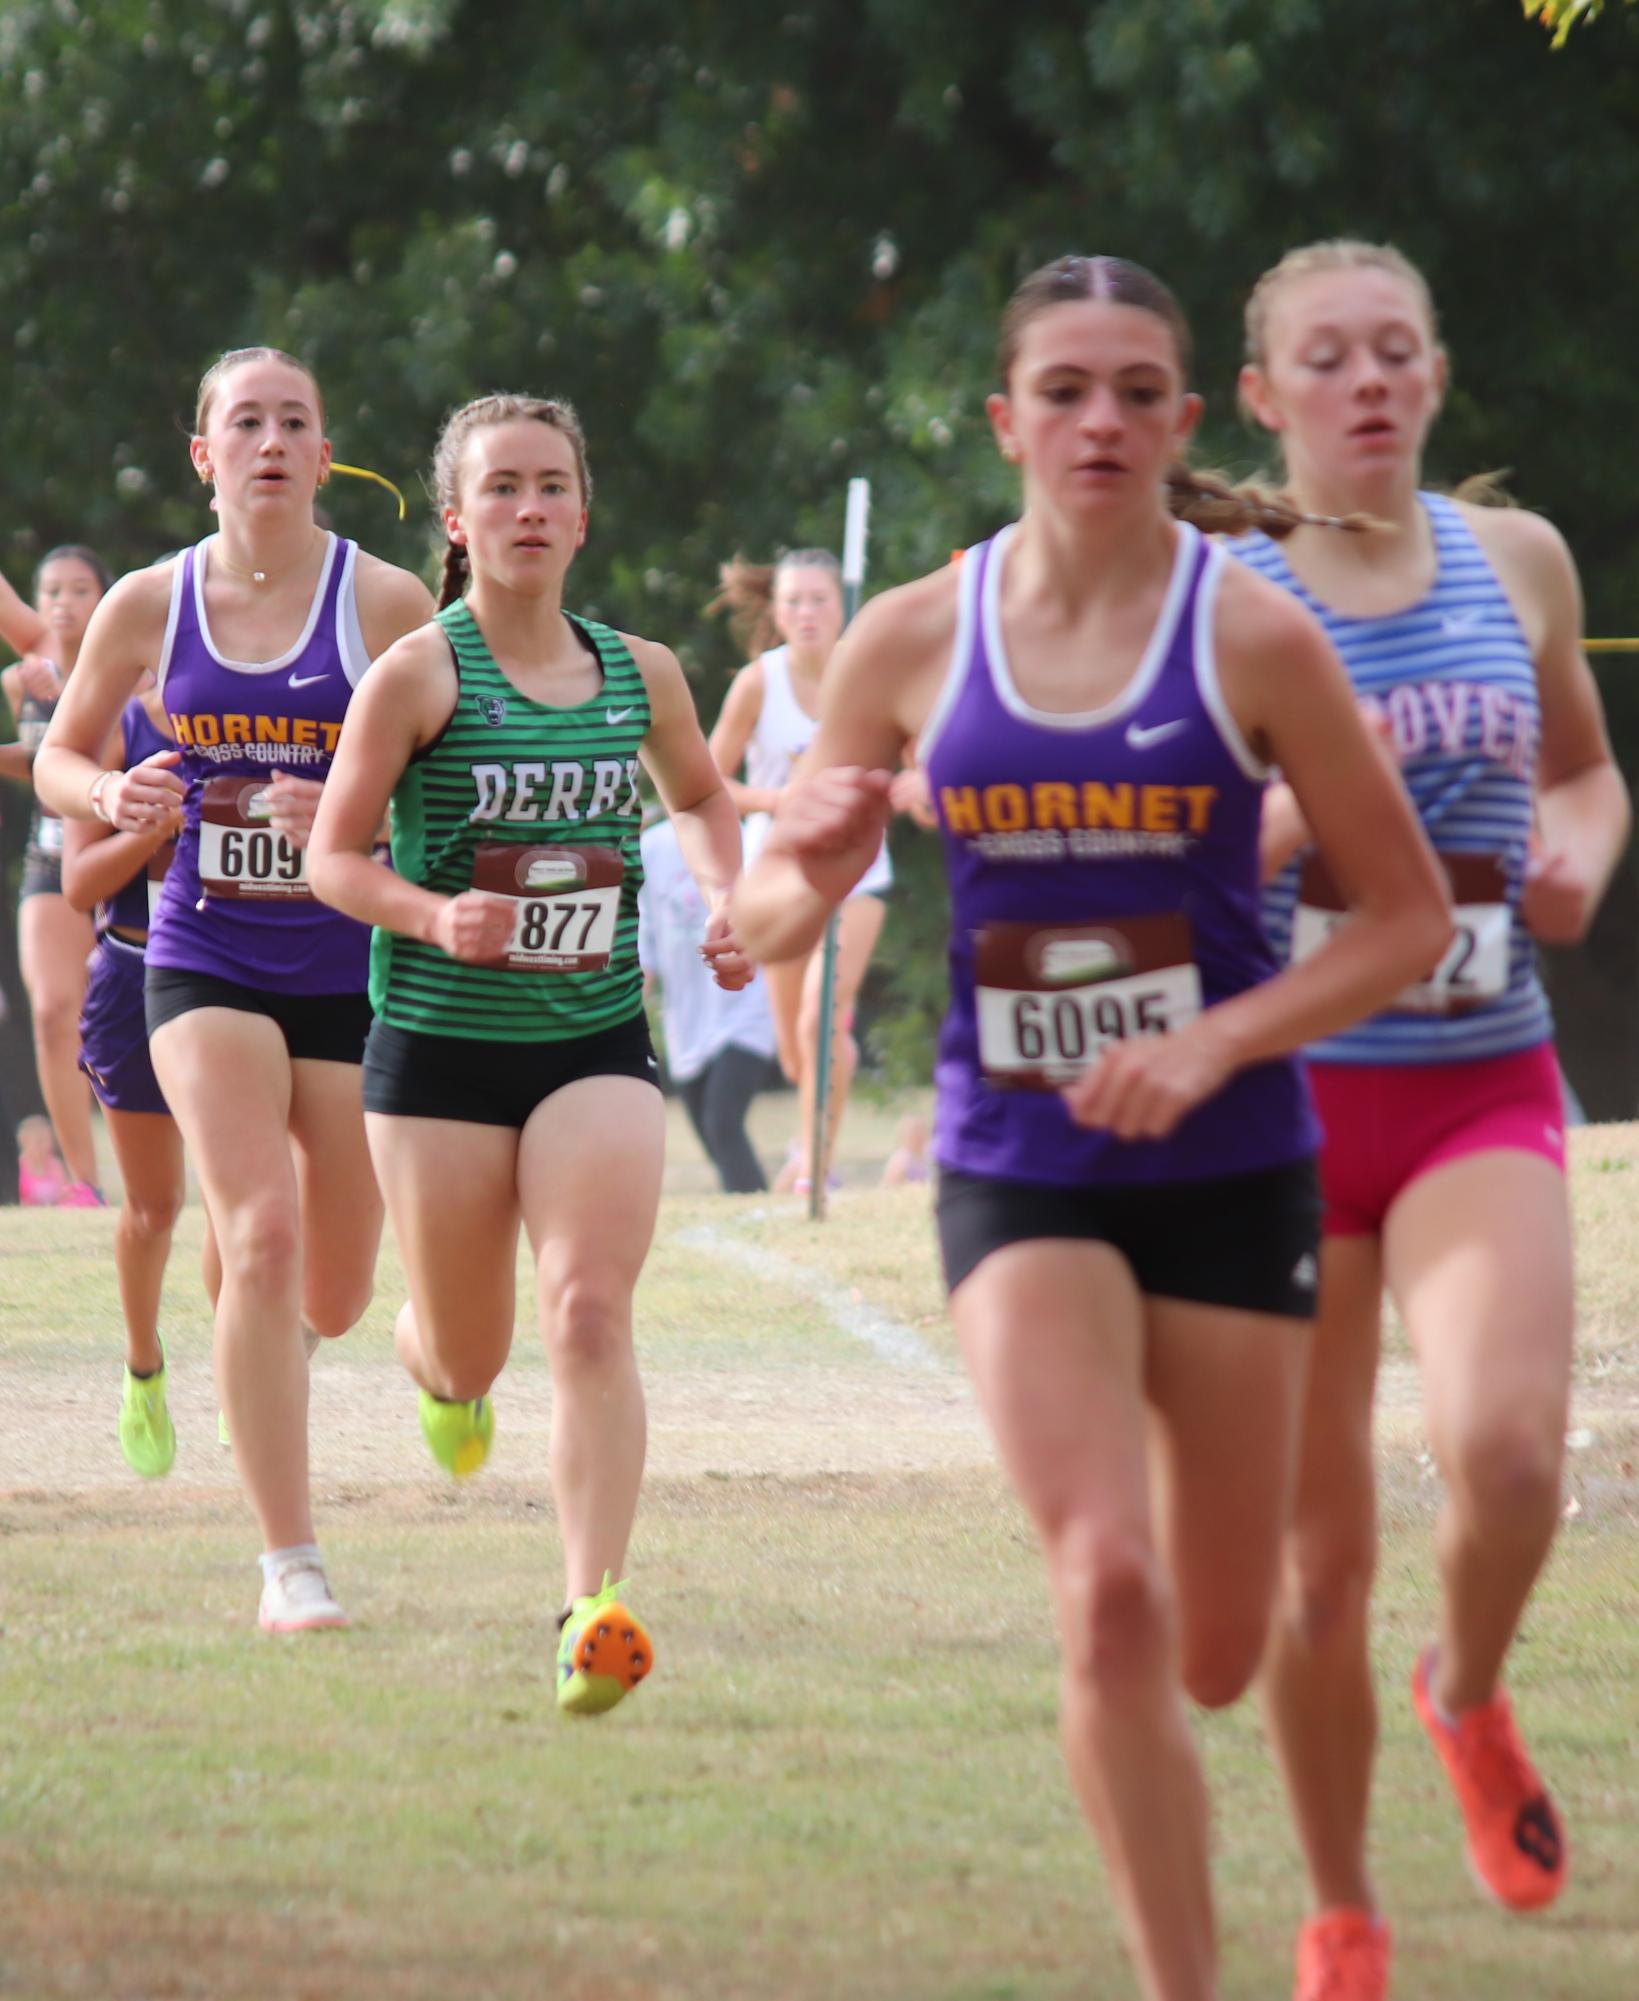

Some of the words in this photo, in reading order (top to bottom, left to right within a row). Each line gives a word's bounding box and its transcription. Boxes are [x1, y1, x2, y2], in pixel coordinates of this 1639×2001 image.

[170, 713, 344, 752] HORNET
[245, 741, 323, 765] COUNTRY
[940, 782, 1218, 835] HORNET
[220, 831, 302, 879] 609
[510, 901, 602, 950] 877
